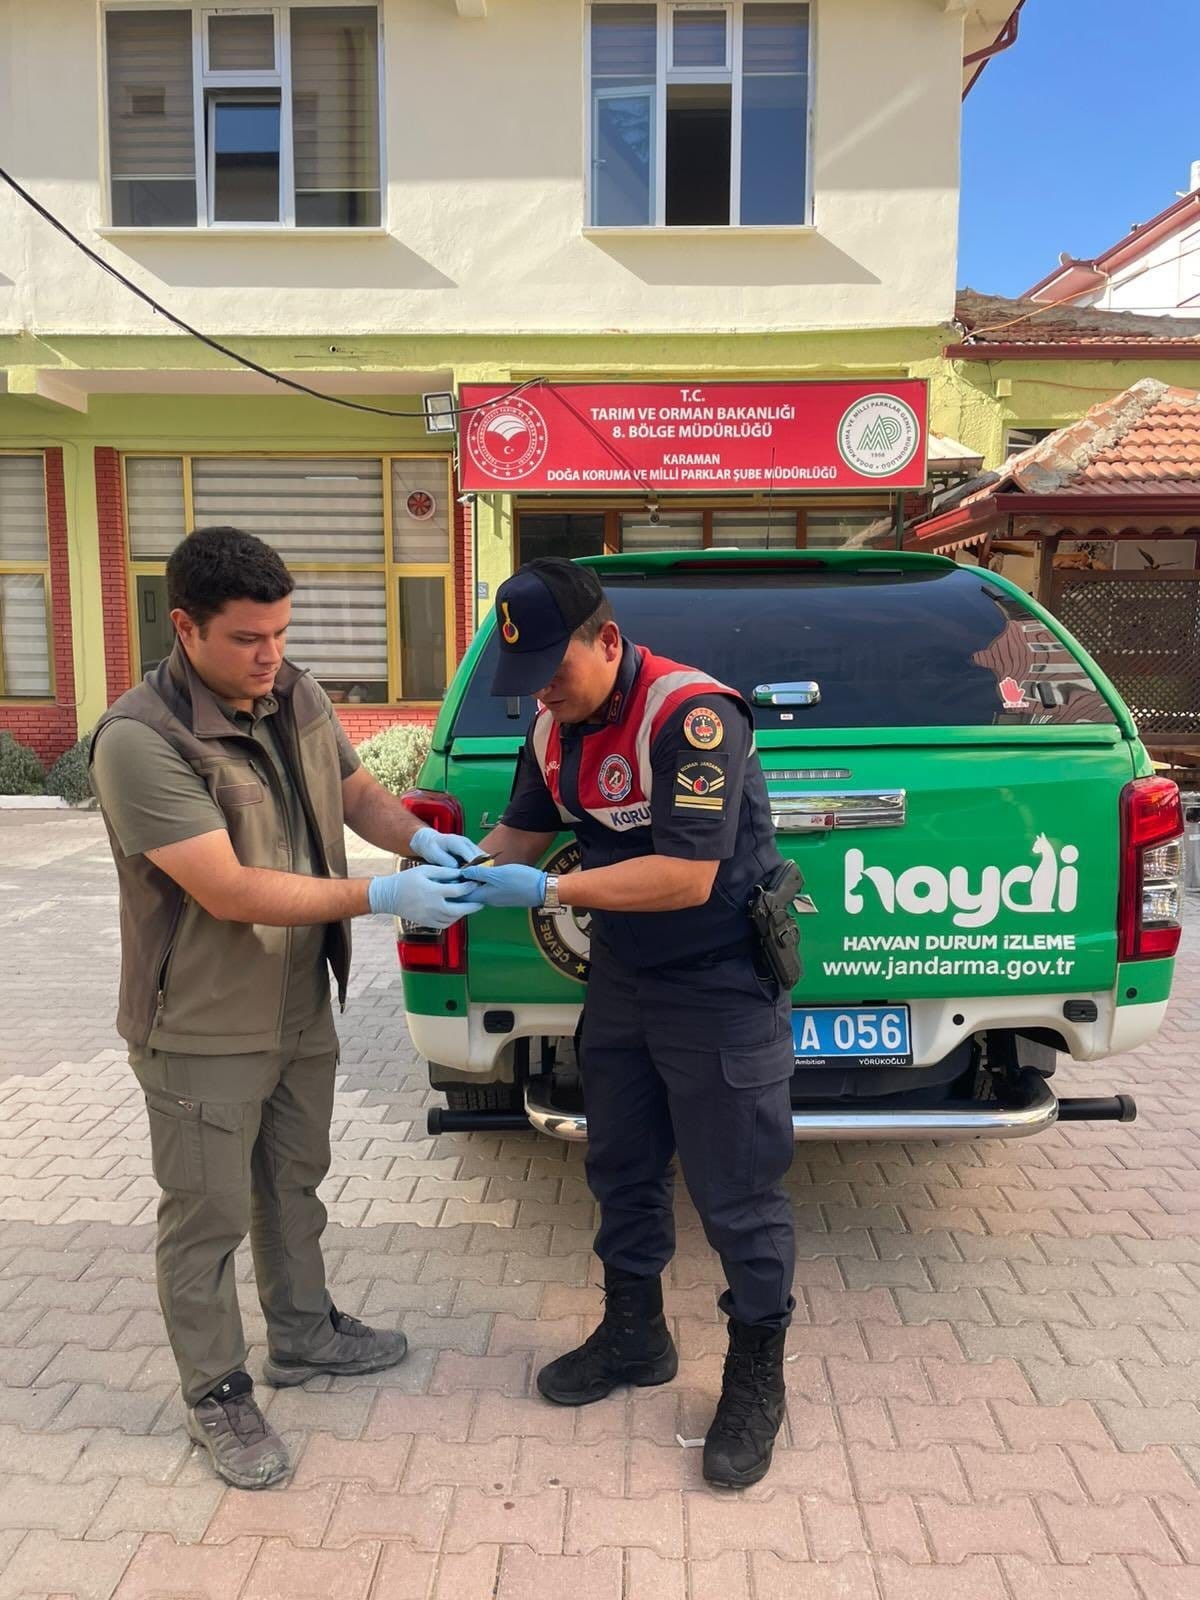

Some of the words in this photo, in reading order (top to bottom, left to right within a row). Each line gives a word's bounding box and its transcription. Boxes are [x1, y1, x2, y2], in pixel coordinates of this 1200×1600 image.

[680, 389, 706, 403] T.C.
[590, 407, 632, 421] TARIM
[634, 407, 657, 420] VE
[659, 406, 714, 420] ORMAN
[716, 404, 796, 420] BAKANLIĞI
[847, 417, 855, 428] VE
[870, 401, 902, 414] PARKLAR
[900, 413, 912, 433] GENEL
[612, 425, 626, 439] 8.
[629, 423, 675, 439] BÖLGE
[678, 422, 773, 438] MÜDÜRLÜĞÜ
[662, 453, 722, 466] KARAMAN
[546, 467, 581, 482] DOĞA
[582, 469, 632, 482] KORUMA
[633, 469, 649, 482] VE
[649, 466, 679, 482] MİLLİ
[680, 468, 732, 481] PARKLAR
[733, 467, 762, 484] ŞUBE
[763, 465, 838, 481] MÜDÜRLÜĞÜ
[610, 805, 651, 827] KORU
[844, 833, 1079, 928] haydi
[843, 935, 920, 951] HAYVAN
[925, 934, 998, 950] DURUM
[822, 955, 1076, 980] www.jandarma.gov.tr
[833, 1013, 902, 1050] 056
[795, 1058, 826, 1066] Ambition
[858, 1057, 907, 1066] YÖRÜKOĞLU
